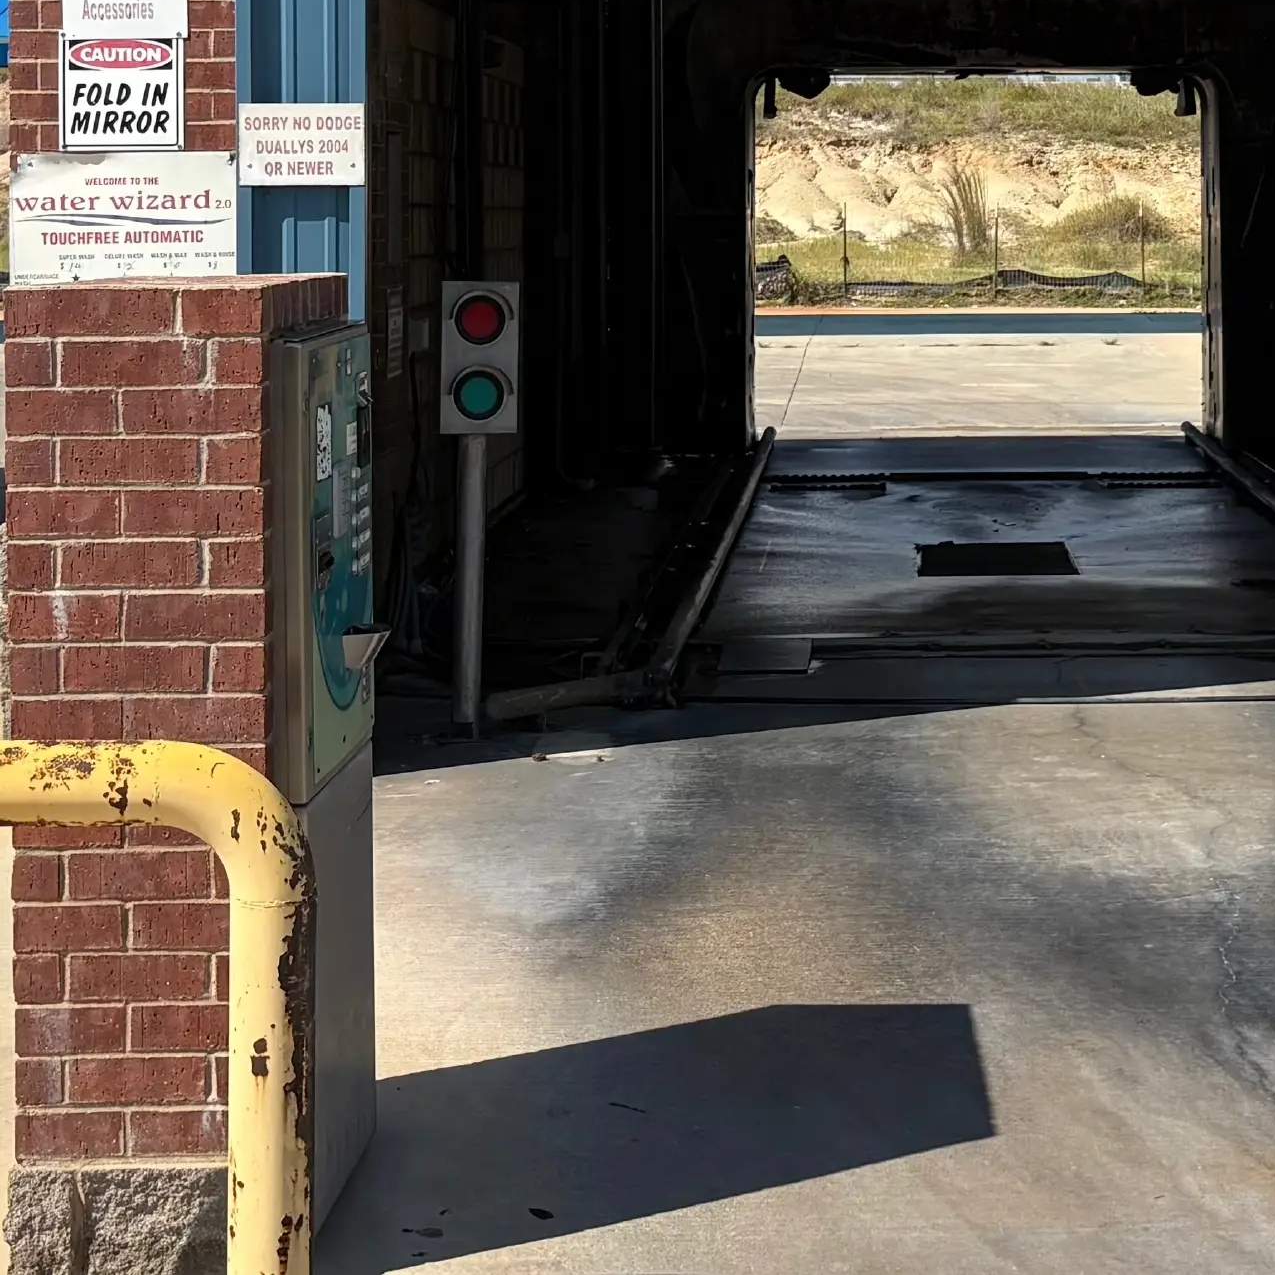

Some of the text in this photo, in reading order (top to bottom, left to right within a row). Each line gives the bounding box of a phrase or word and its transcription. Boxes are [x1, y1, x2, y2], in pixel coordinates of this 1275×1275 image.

[82, 0, 154, 20] Accessories
[80, 46, 162, 62] CAUTION
[73, 82, 169, 106] FOLD IN
[70, 110, 170, 134] MIRROR
[244, 116, 361, 130] SORRY NO DODGE
[256, 139, 348, 154] DUALLYS 2004
[265, 161, 333, 176] OR NEWER
[85, 177, 159, 186] WELCOME TO THE
[15, 189, 231, 212] water wizard 2.0
[41, 230, 204, 245] TOUCHFREE AUTOMATIC
